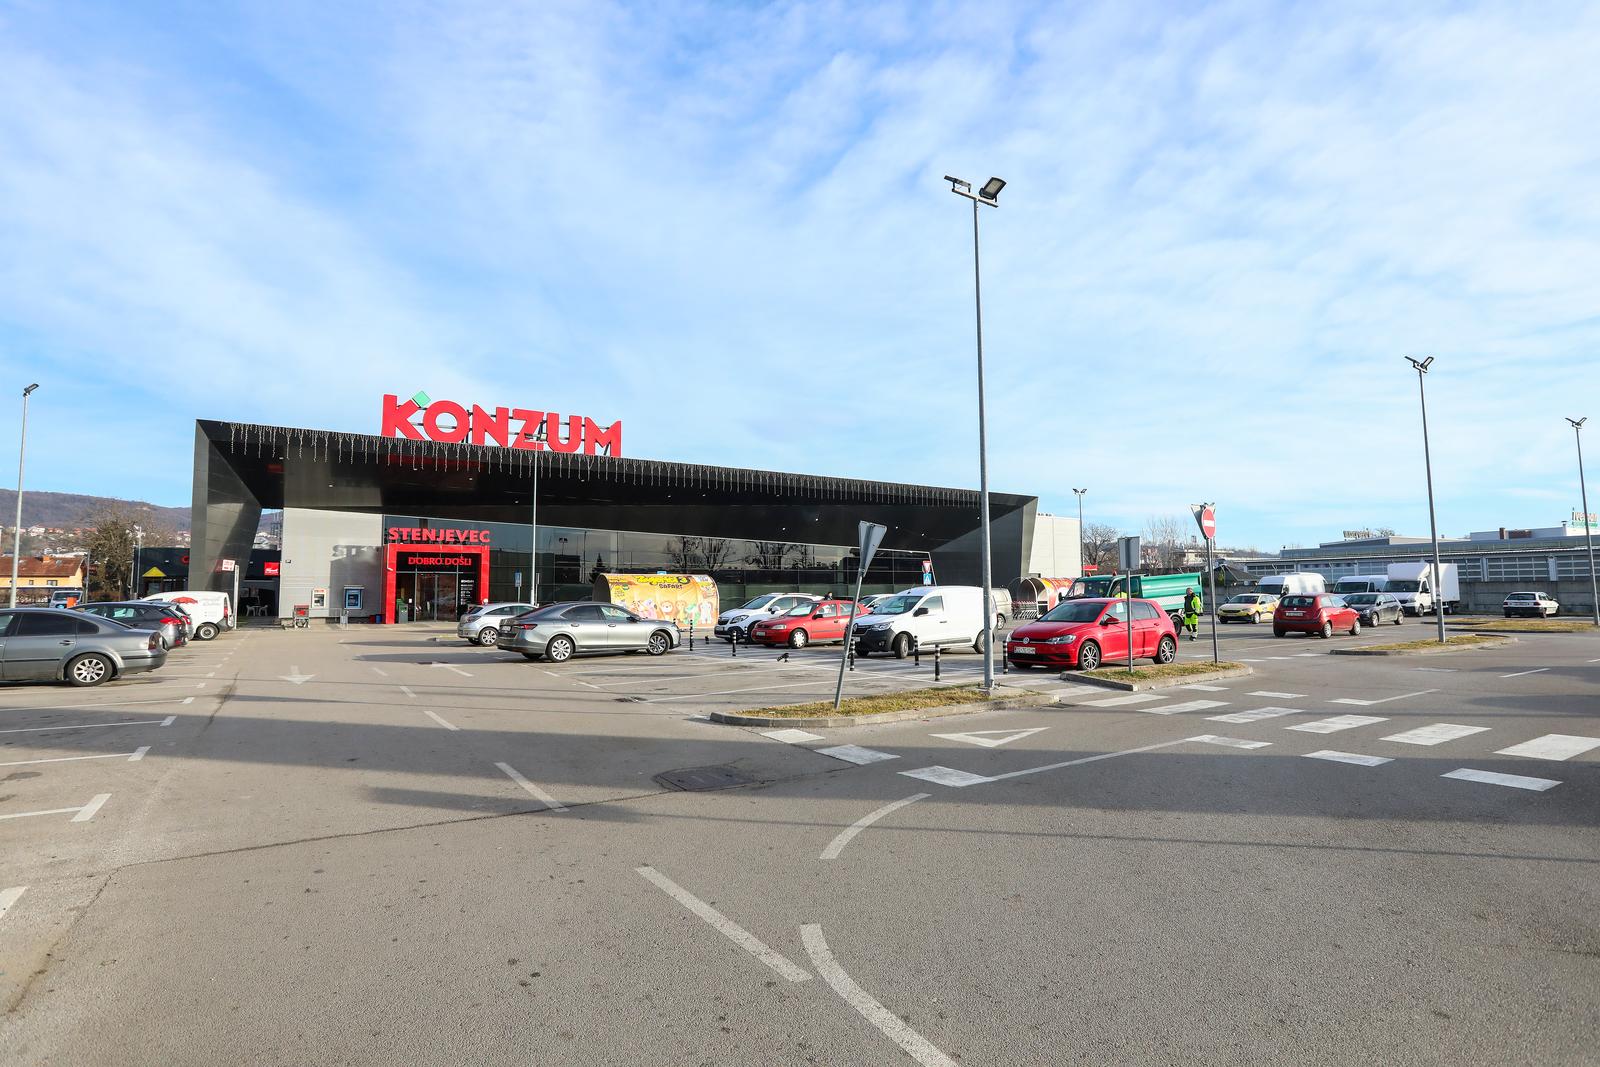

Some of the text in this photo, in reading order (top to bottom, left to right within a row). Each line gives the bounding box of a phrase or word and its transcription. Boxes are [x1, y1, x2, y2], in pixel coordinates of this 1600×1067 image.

[380, 393, 622, 458] KONZUM
[388, 527, 491, 543] STENJEVEC
[408, 556, 472, 566] DOBRO DOŠLI
